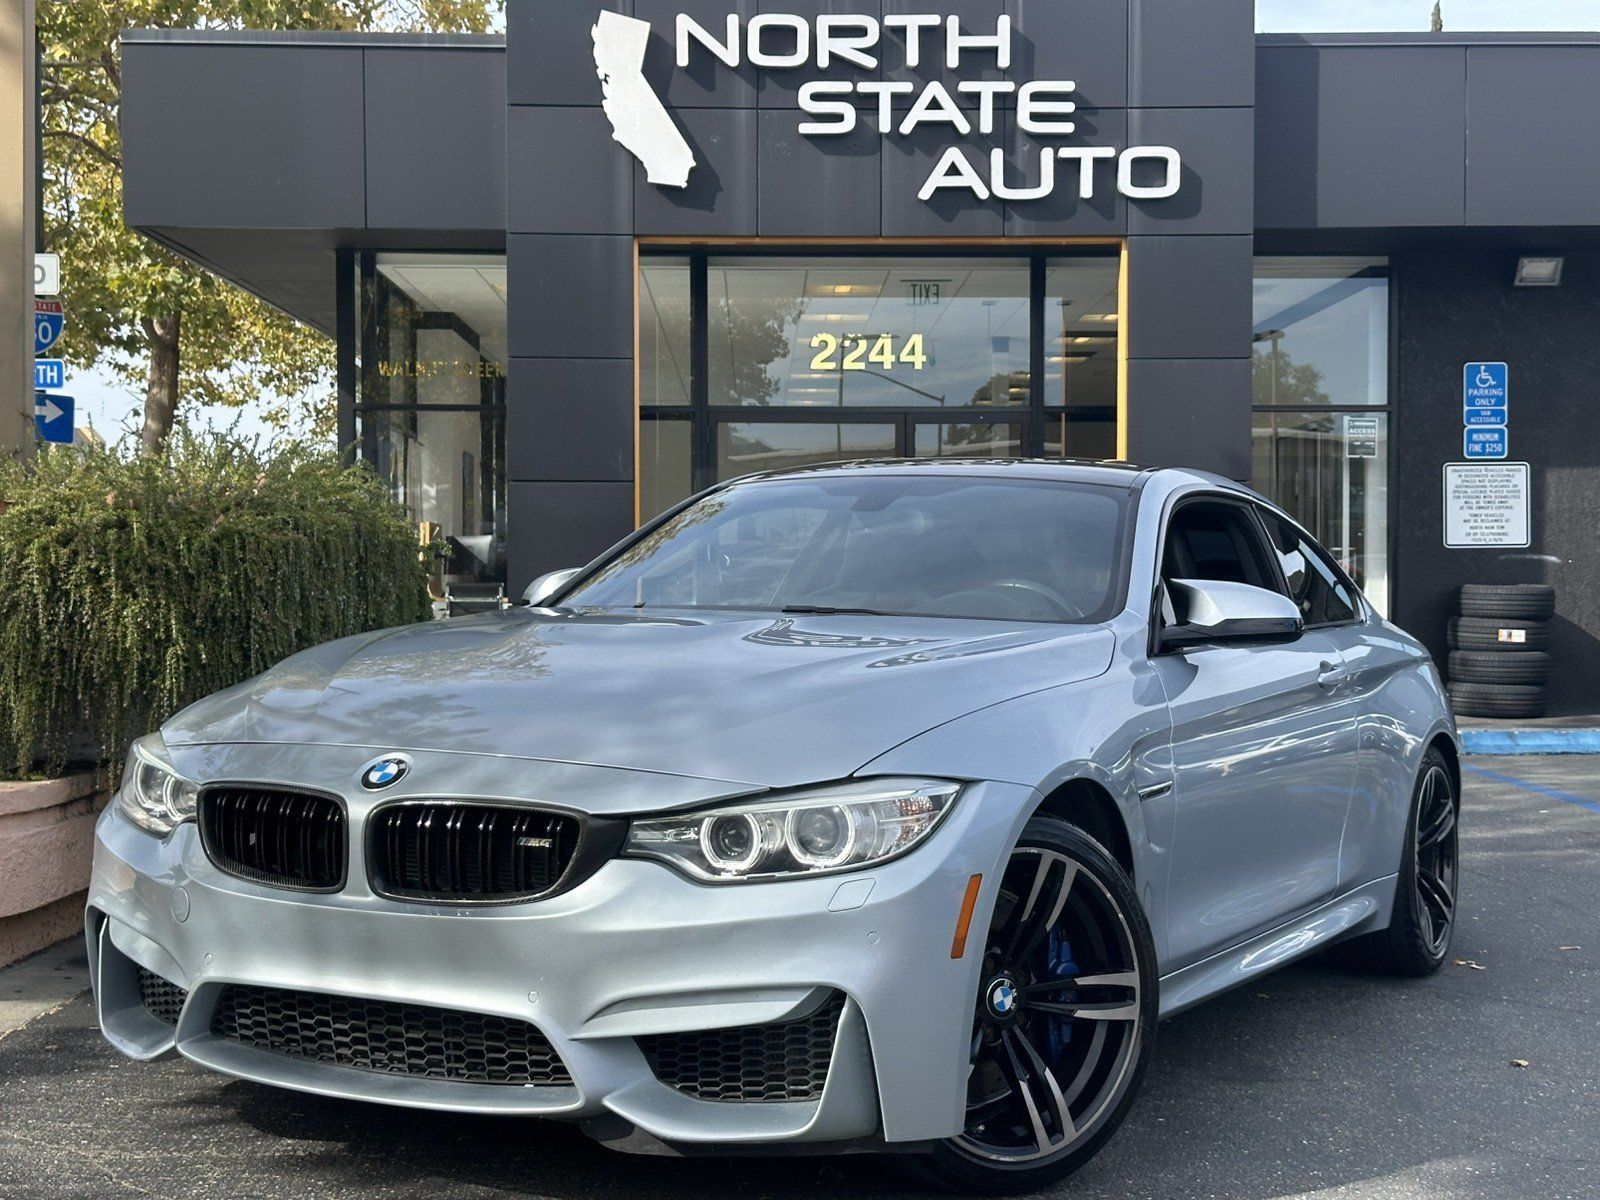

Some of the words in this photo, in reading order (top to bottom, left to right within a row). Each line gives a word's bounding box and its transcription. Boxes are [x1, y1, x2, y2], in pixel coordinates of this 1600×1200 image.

[675, 13, 1011, 69] NORTH
[797, 80, 1076, 135] STATE
[918, 146, 1181, 200] AUTO
[810, 332, 927, 370] 2244
[35, 365, 58, 384] TH
[1469, 388, 1503, 396] PARKING
[1475, 398, 1496, 406] ONLY
[1472, 433, 1499, 441] MINIMUM
[1469, 443, 1482, 452] FINE
[1485, 443, 1502, 453] $250
